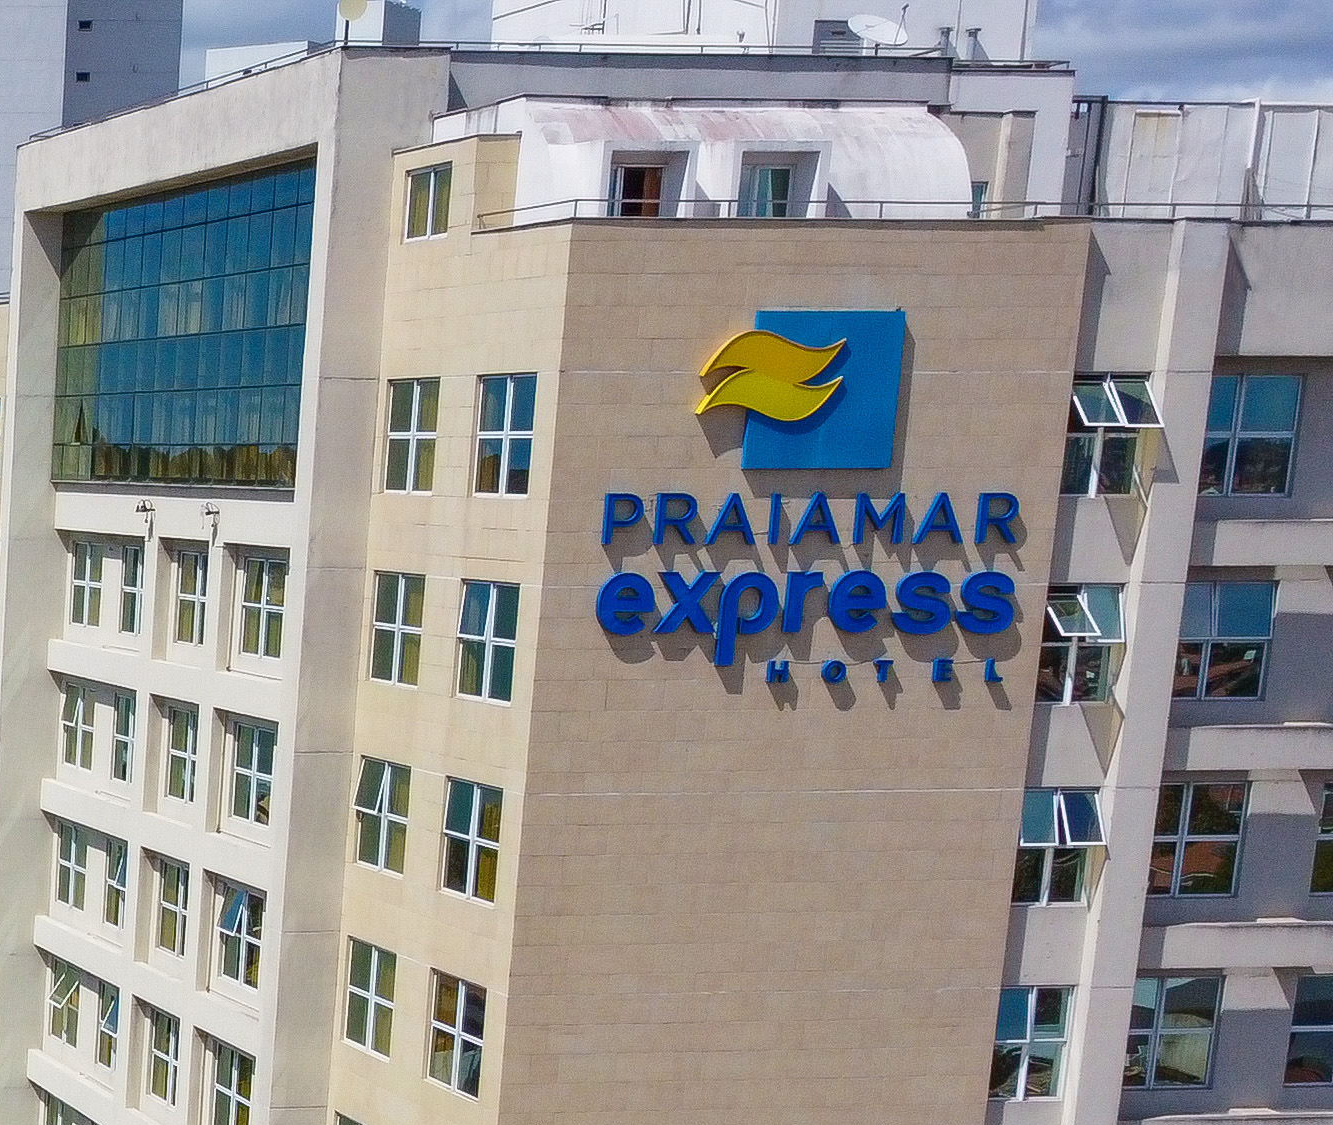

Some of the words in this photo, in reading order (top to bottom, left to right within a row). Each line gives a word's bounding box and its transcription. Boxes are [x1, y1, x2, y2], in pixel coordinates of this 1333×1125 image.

[601, 492, 1021, 546] PRAIAMAR
[596, 571, 1017, 666] express
[766, 659, 1004, 683] HOTEL
